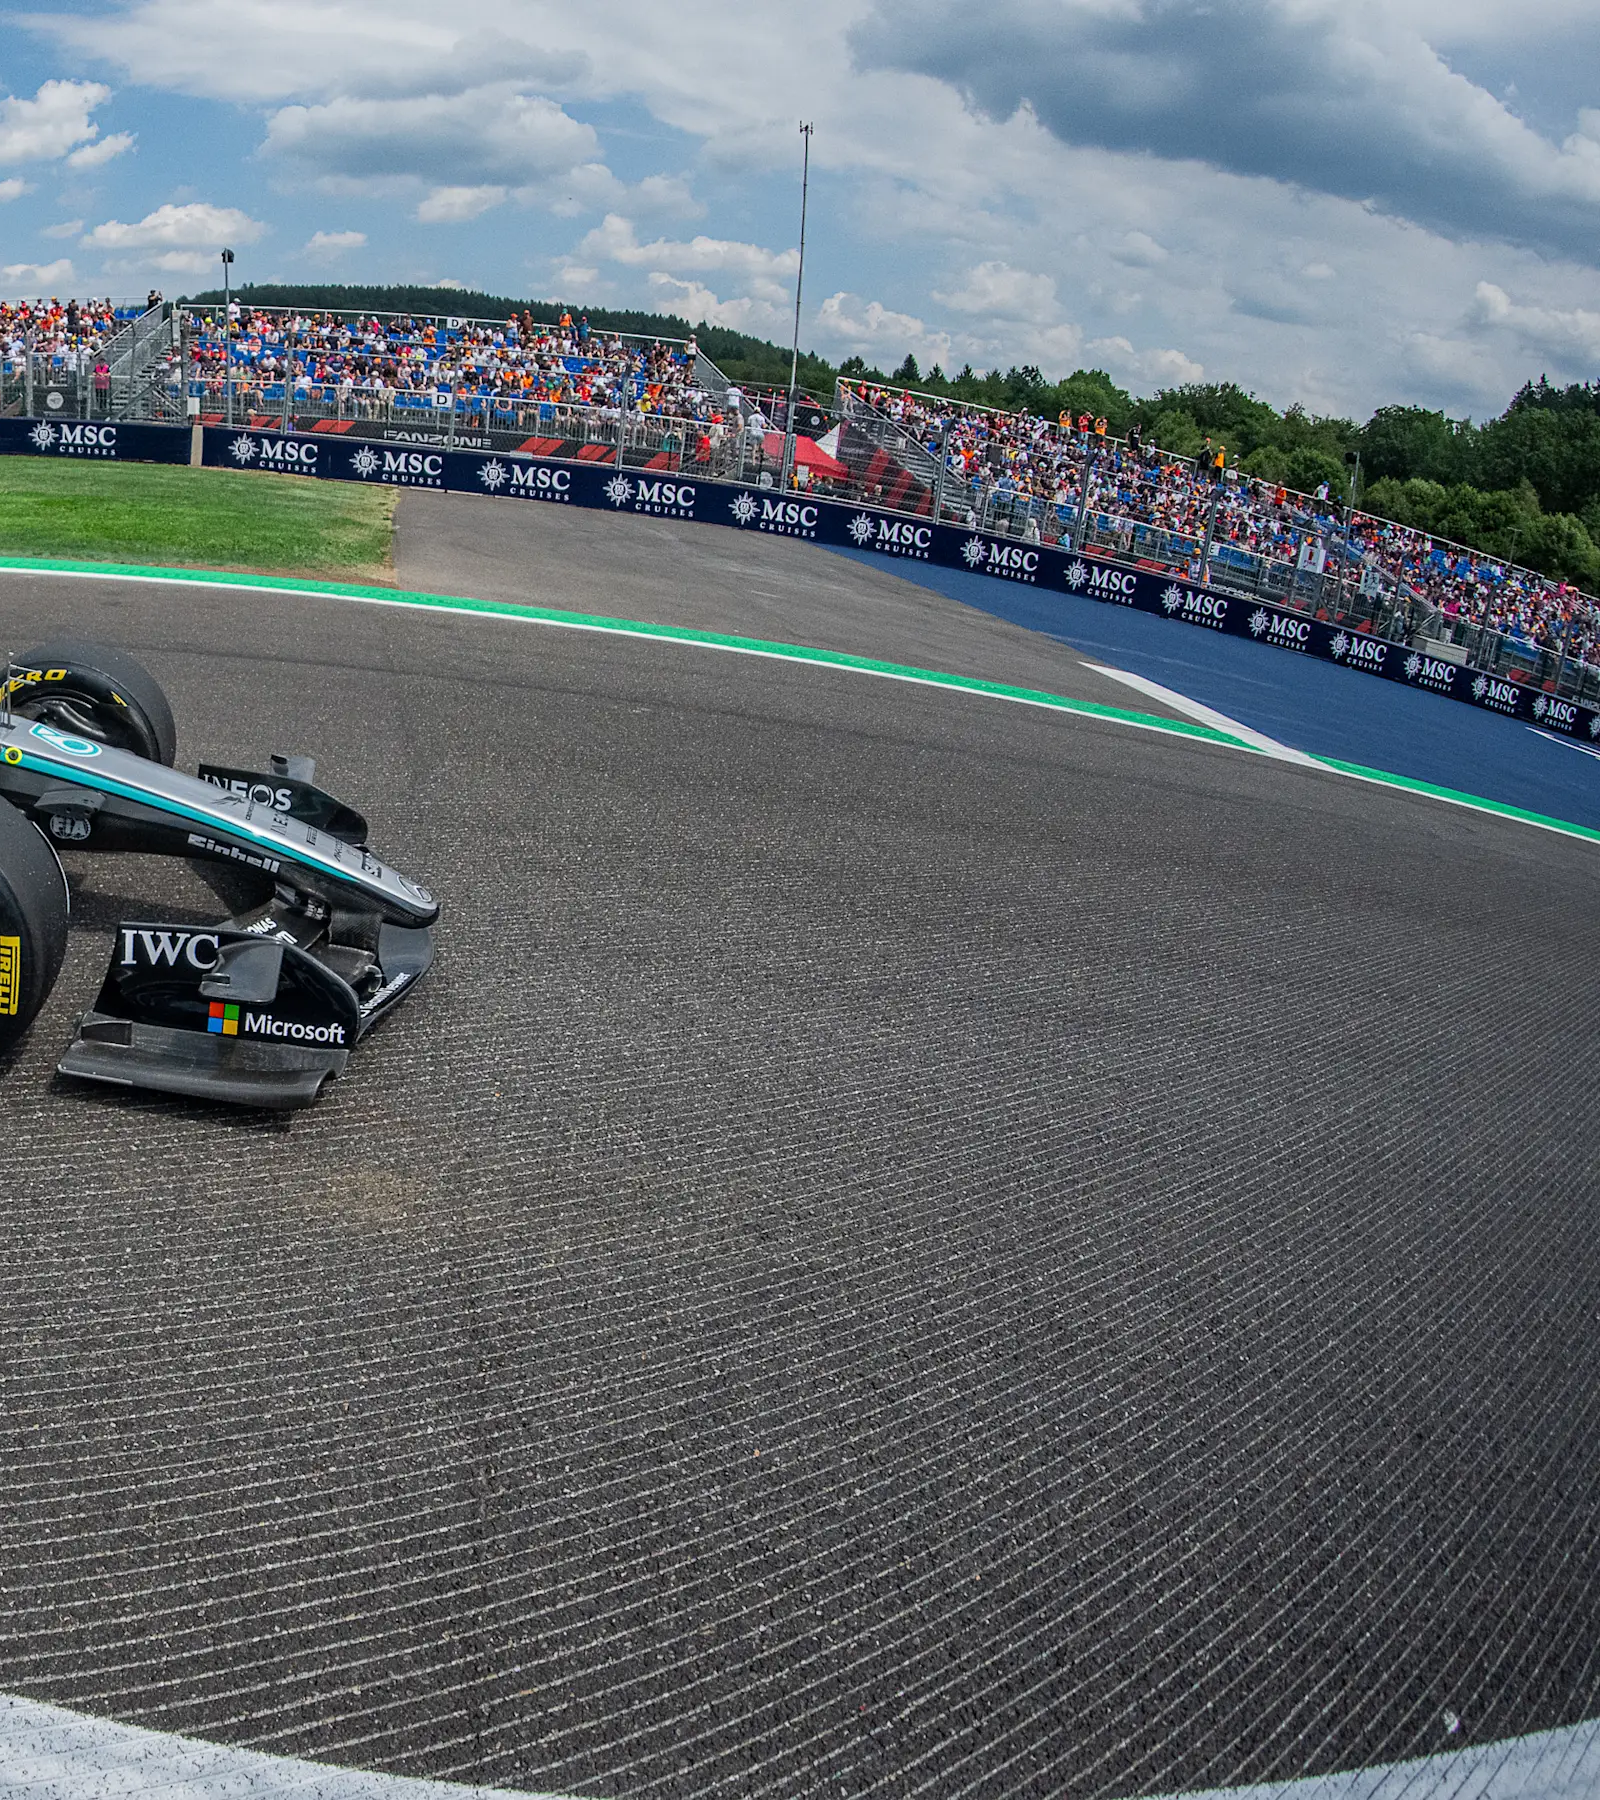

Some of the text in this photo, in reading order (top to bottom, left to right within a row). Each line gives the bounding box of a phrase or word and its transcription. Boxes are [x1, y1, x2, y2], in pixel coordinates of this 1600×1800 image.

[436, 395, 447, 405] D
[60, 424, 116, 446] MSC
[384, 430, 491, 448] FANZONE
[60, 446, 116, 456] CRUISES
[260, 438, 318, 463] MSC
[260, 460, 316, 474] CRUISES
[384, 451, 442, 475] MSC
[382, 473, 442, 486] CRUISES
[511, 465, 570, 490] MSC
[510, 488, 569, 500] CRUISES
[636, 480, 696, 506] MSC
[635, 503, 694, 518] CRUISES
[762, 499, 818, 527] MSC
[760, 522, 816, 538] CRUISES
[877, 520, 932, 548] MSC
[876, 542, 929, 558] CRUISES
[988, 543, 1039, 572] MSC
[986, 565, 1036, 582] CRUISES
[1088, 566, 1136, 594] MSC
[1087, 588, 1132, 604] CRUISES
[1183, 590, 1228, 618] MSC
[1182, 612, 1223, 628] CRUISES
[1269, 615, 1310, 642] MSC
[1267, 635, 1306, 651] CRUISES
[1349, 638, 1387, 662] MSC
[1421, 658, 1456, 682] MSC
[1487, 680, 1519, 704] MSC
[1547, 700, 1576, 722] MSC
[203, 774, 292, 811] INEOS
[54, 817, 89, 838] FIA
[188, 833, 281, 874] Einhell
[120, 929, 219, 970] IWC
[244, 1012, 346, 1044] Microsoft
